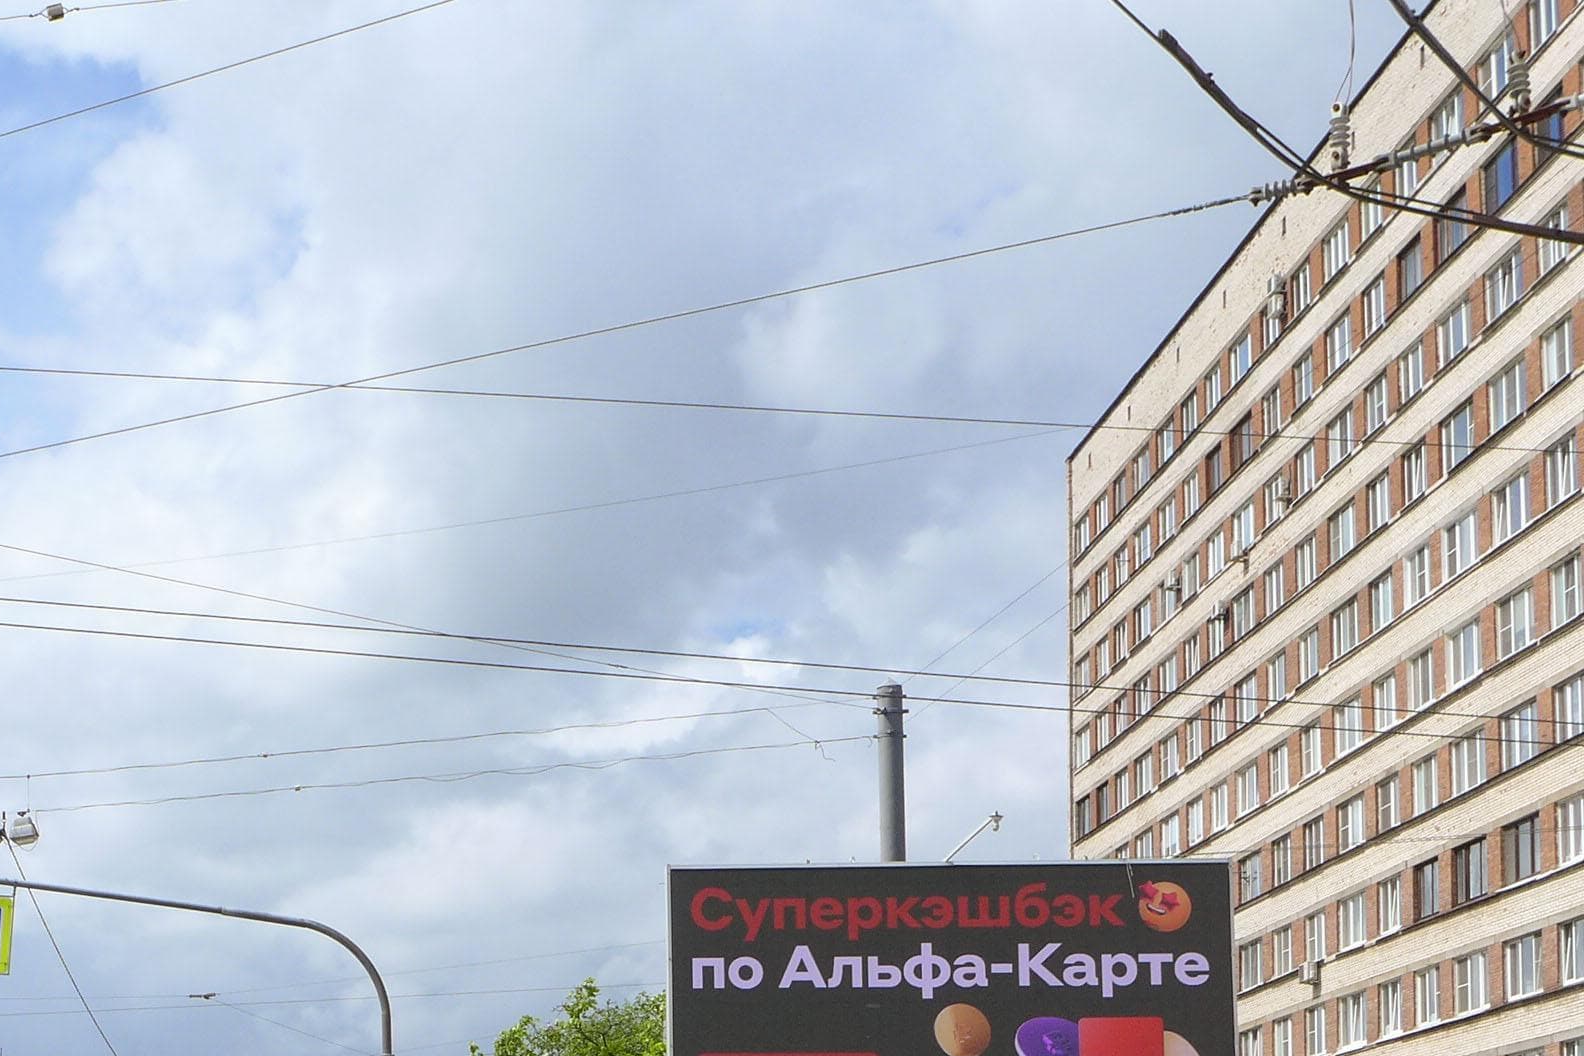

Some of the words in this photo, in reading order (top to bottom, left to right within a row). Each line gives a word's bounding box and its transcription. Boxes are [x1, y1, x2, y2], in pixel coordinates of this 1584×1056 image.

[691, 882, 1125, 942] Суперкэшбэк
[692, 955, 764, 989] по
[778, 942, 1210, 999] Альфа-Карте
